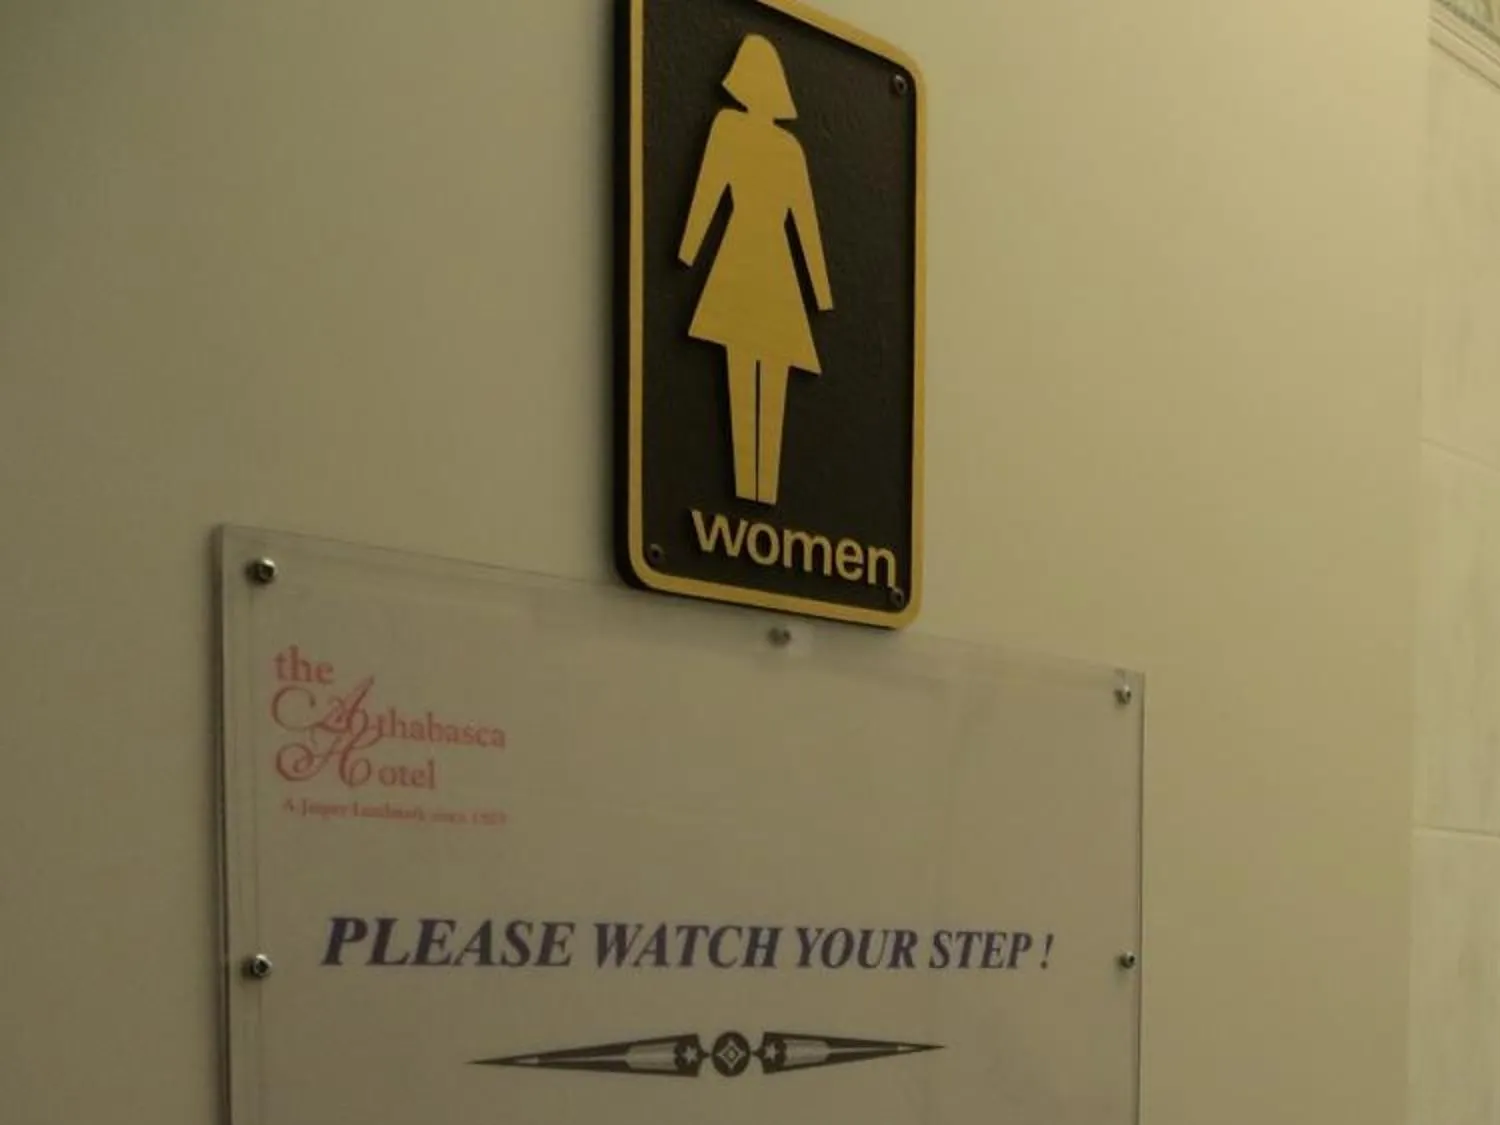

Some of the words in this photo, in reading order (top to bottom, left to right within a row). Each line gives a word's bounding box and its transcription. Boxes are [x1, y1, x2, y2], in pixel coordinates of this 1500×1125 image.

[691, 508, 897, 588] women
[273, 644, 335, 684] the
[271, 676, 506, 748] Athabasca
[275, 734, 435, 789] Hotel
[320, 916, 576, 967] PLEASE
[592, 922, 783, 968] WATCH
[795, 927, 918, 968] YOUR
